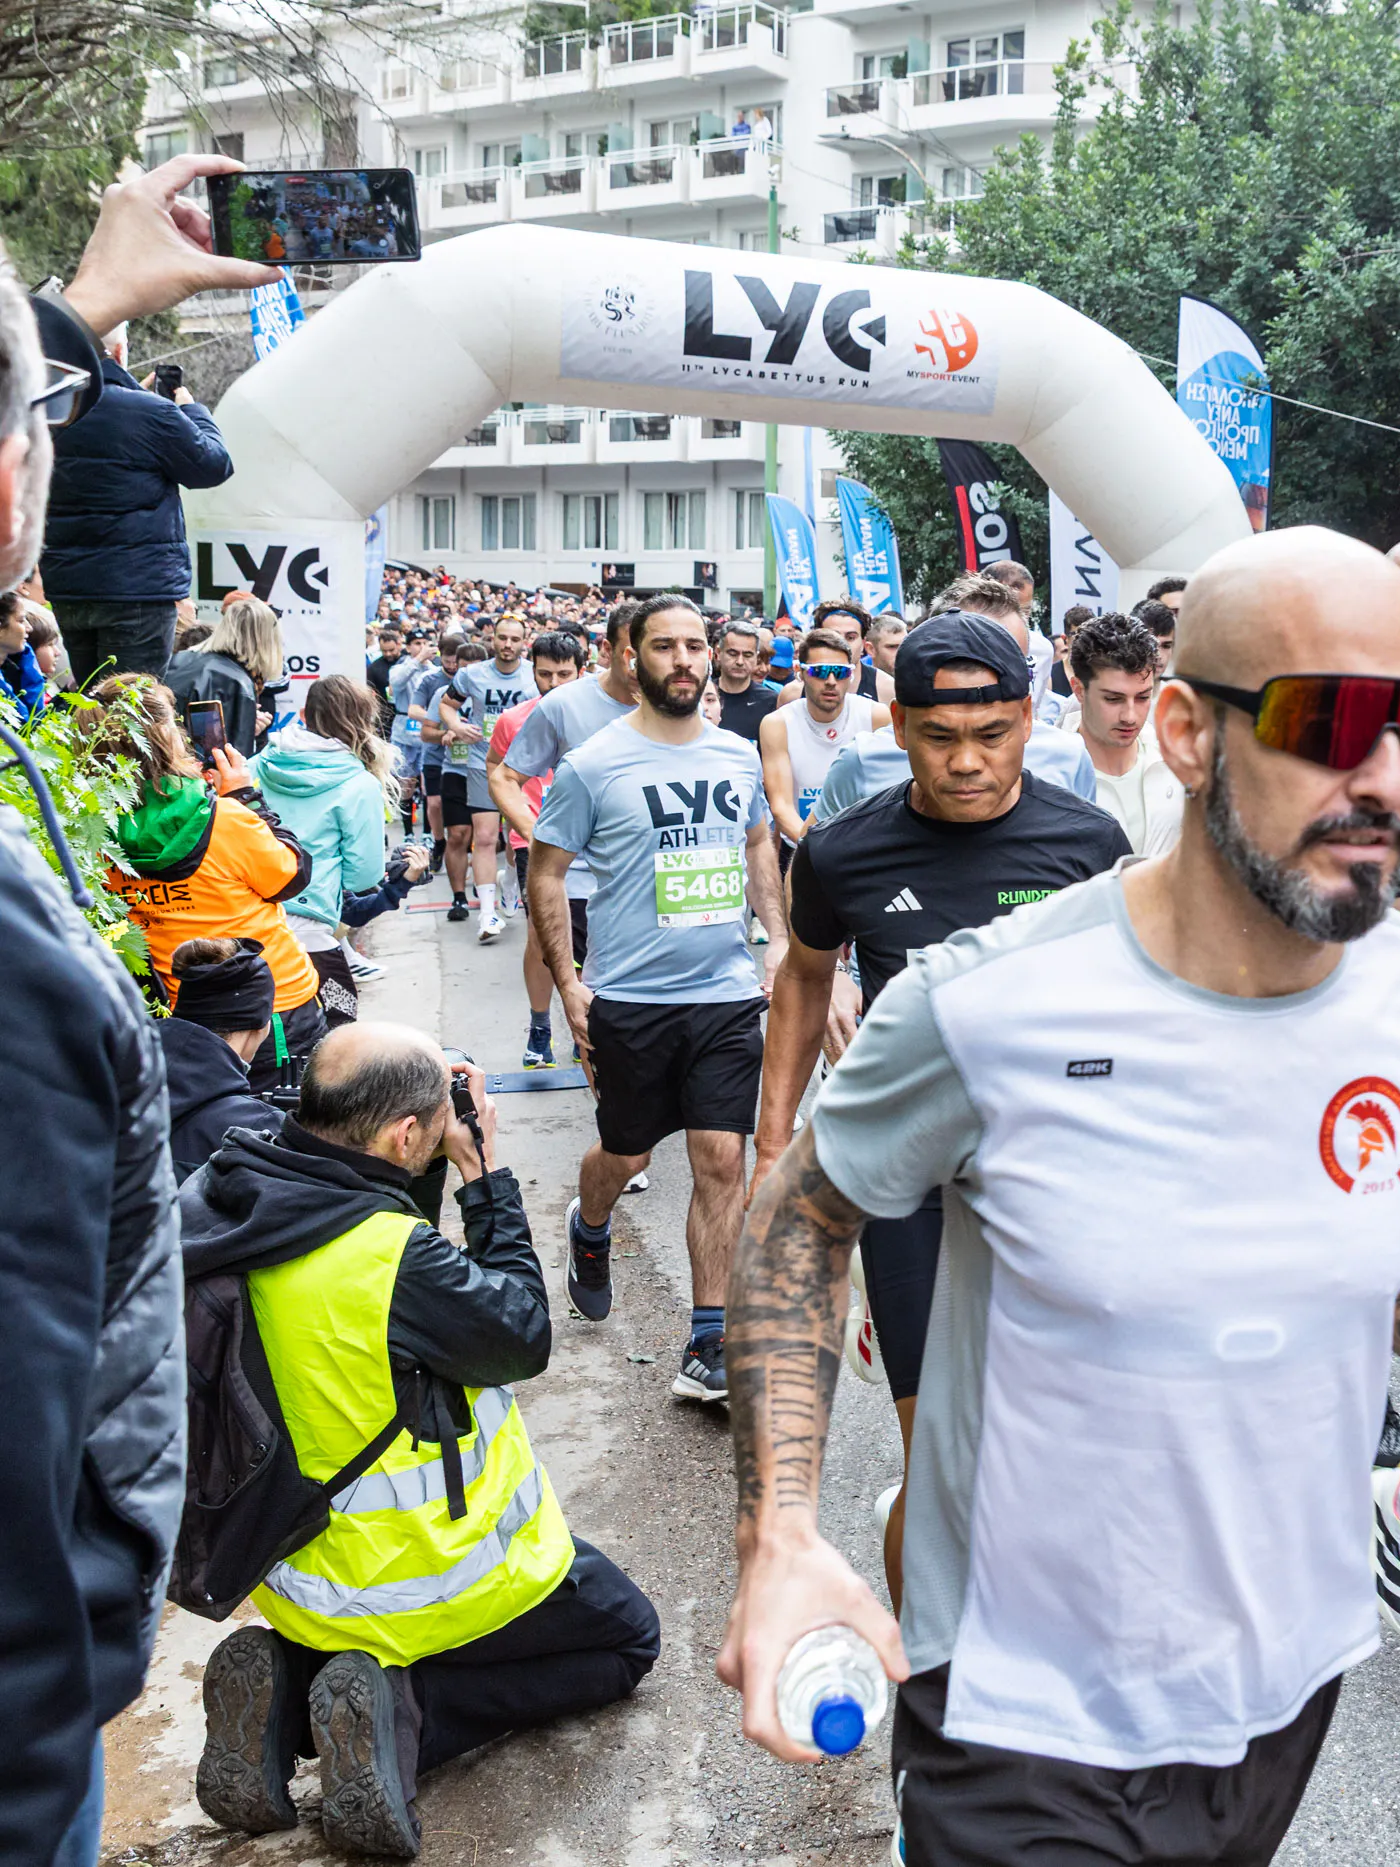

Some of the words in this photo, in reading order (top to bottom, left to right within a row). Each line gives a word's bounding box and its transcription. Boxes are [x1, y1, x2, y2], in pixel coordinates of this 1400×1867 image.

[683, 269, 886, 373] LYC
[712, 366, 826, 385] LYCABETTUS
[838, 377, 871, 389] RUN
[906, 370, 980, 384] MYSPORTEVENT
[197, 541, 329, 604] LYC
[286, 655, 321, 673] OS
[641, 779, 741, 829] LYC
[659, 825, 735, 849] ATHLETE
[662, 853, 694, 868] LYC
[112, 883, 192, 907] ΕΧΕΙΣ
[664, 870, 741, 903] 5468
